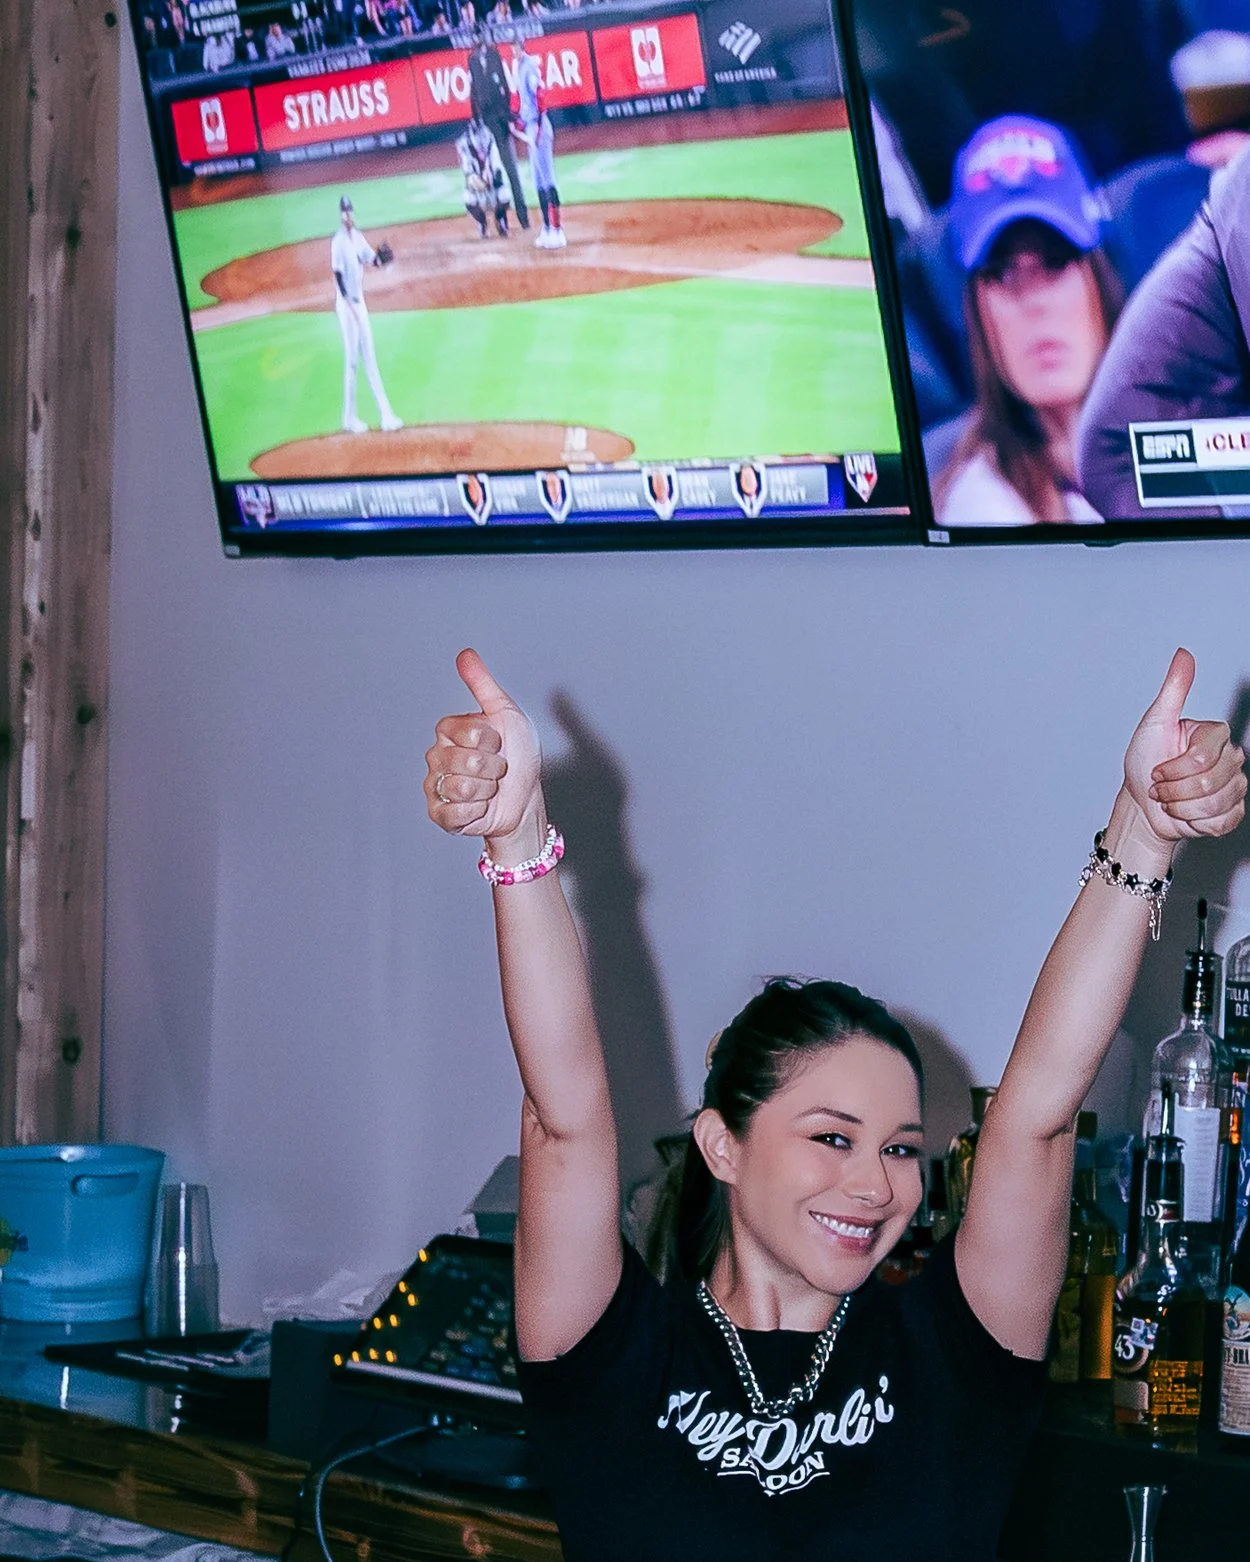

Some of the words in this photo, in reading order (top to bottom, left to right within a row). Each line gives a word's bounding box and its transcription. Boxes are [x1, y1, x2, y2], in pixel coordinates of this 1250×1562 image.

[283, 79, 390, 131] STRAUSS
[425, 47, 584, 105] WOWAR
[1114, 1334, 1136, 1360] 43
